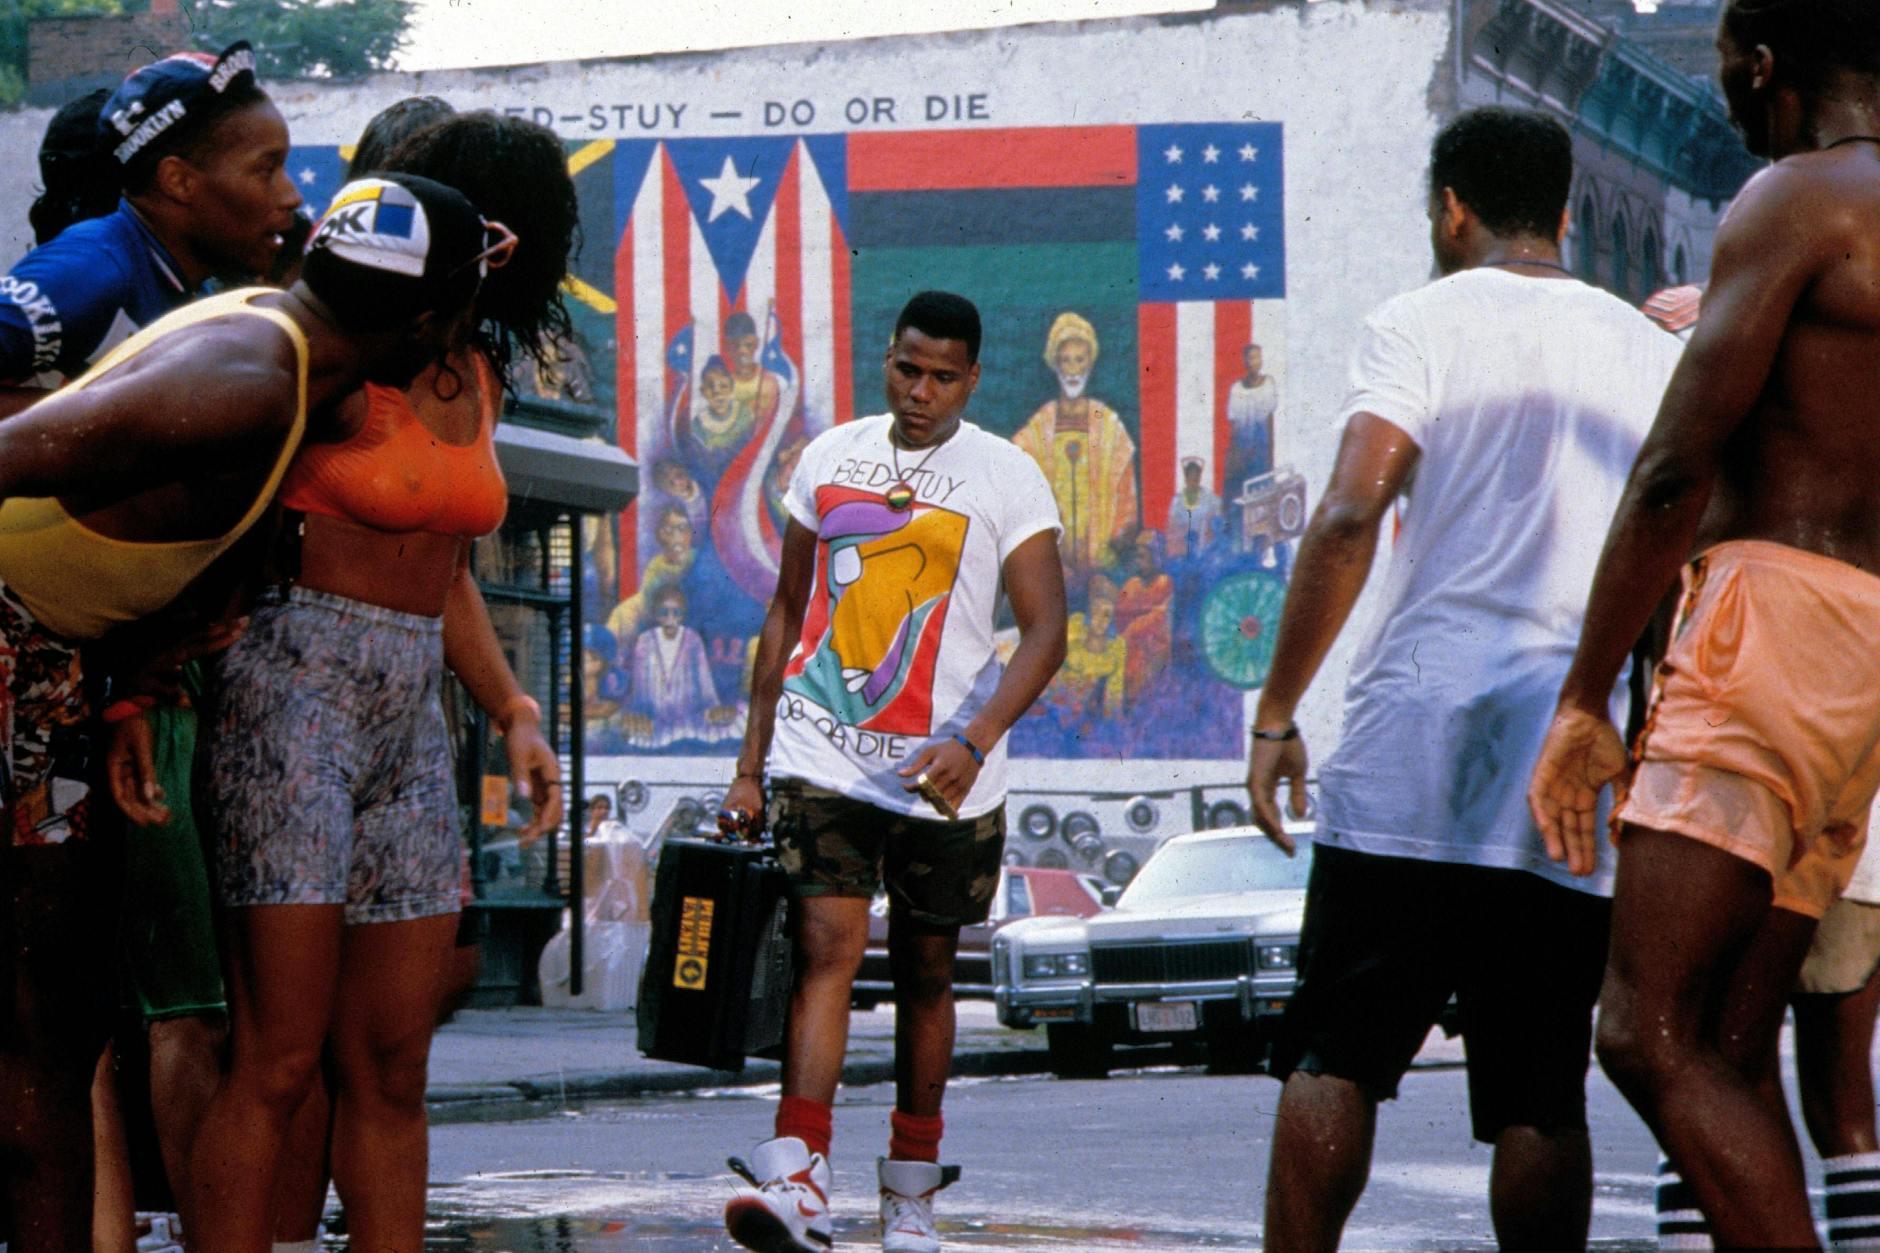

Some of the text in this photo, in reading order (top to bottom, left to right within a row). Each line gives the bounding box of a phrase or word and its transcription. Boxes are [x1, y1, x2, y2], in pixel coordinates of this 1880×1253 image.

[763, 100, 816, 127] DO
[845, 97, 897, 124] OR
[925, 94, 990, 121] DIE
[855, 732, 908, 759] DIE
